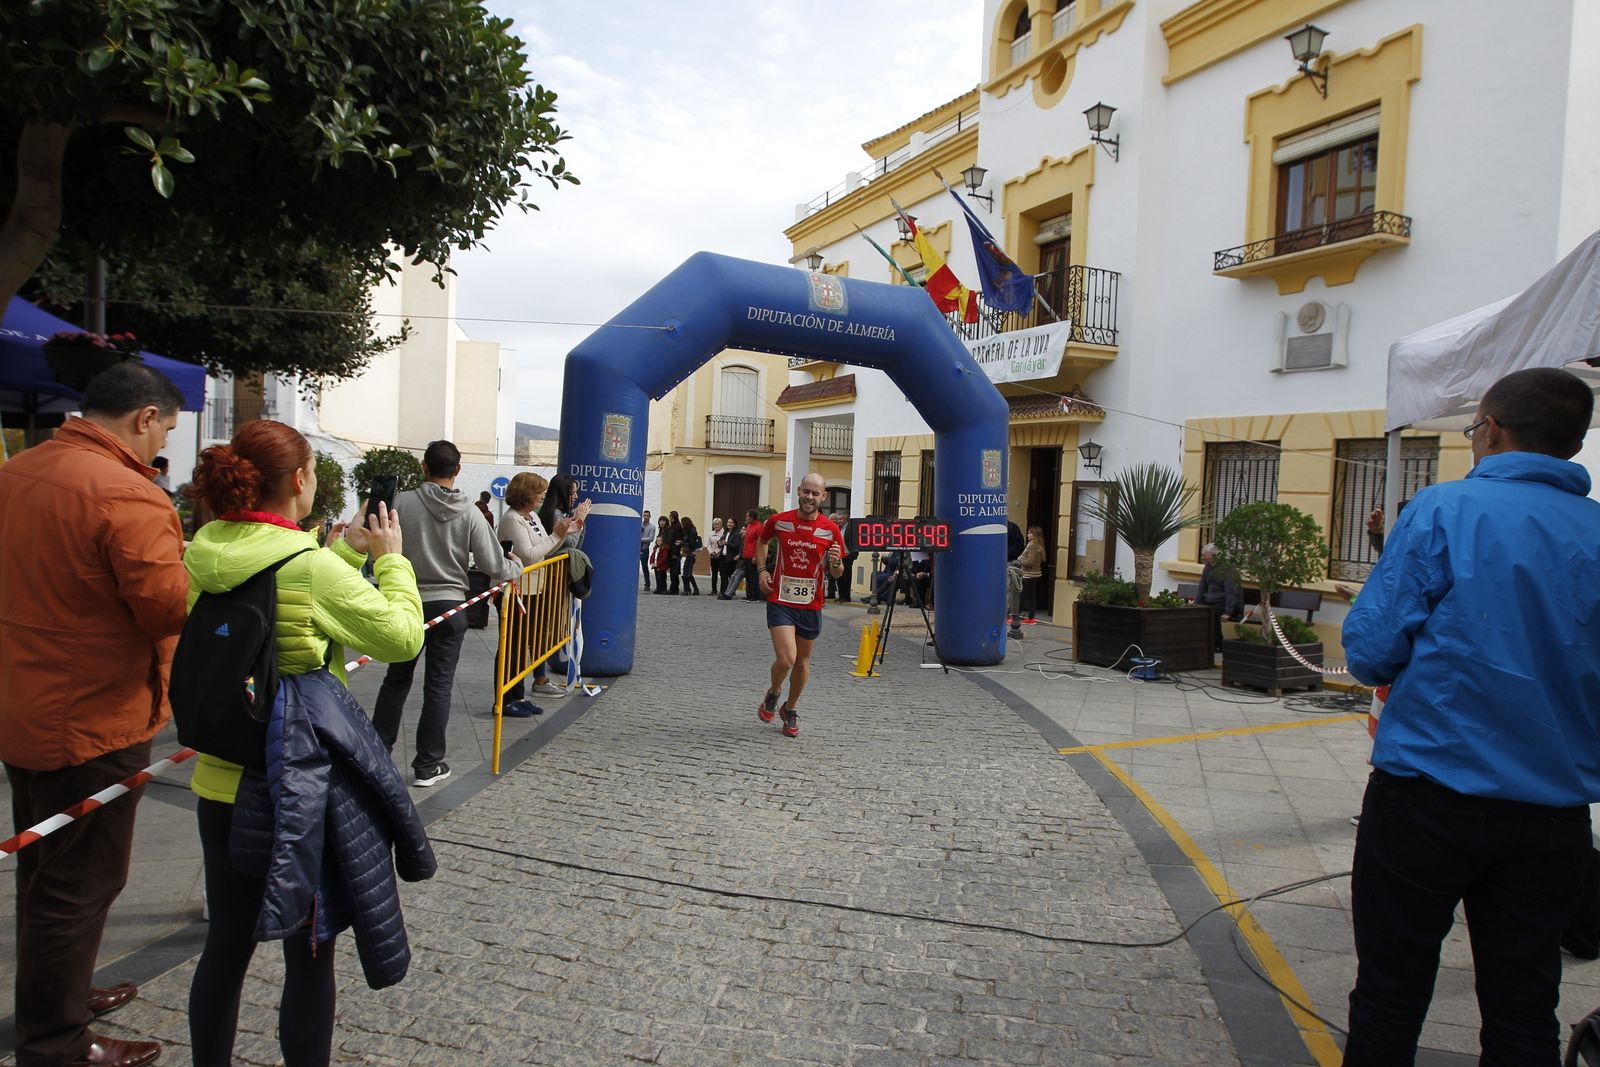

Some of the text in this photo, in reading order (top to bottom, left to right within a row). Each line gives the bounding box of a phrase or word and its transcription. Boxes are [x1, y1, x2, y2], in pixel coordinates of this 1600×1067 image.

[748, 306, 896, 341] DIPUTACIÓN DE ALMERÍA
[1007, 339, 1019, 360] DE
[1021, 337, 1031, 357] LA
[1033, 334, 1050, 356] UVA
[570, 464, 644, 482] DIPUTACIÓN
[591, 481, 643, 497] ALMERÍA
[958, 493, 1008, 504] DIPUTACI
[960, 506, 976, 517] DE
[858, 523, 948, 547] 00:56:40
[793, 586, 808, 597] 38
